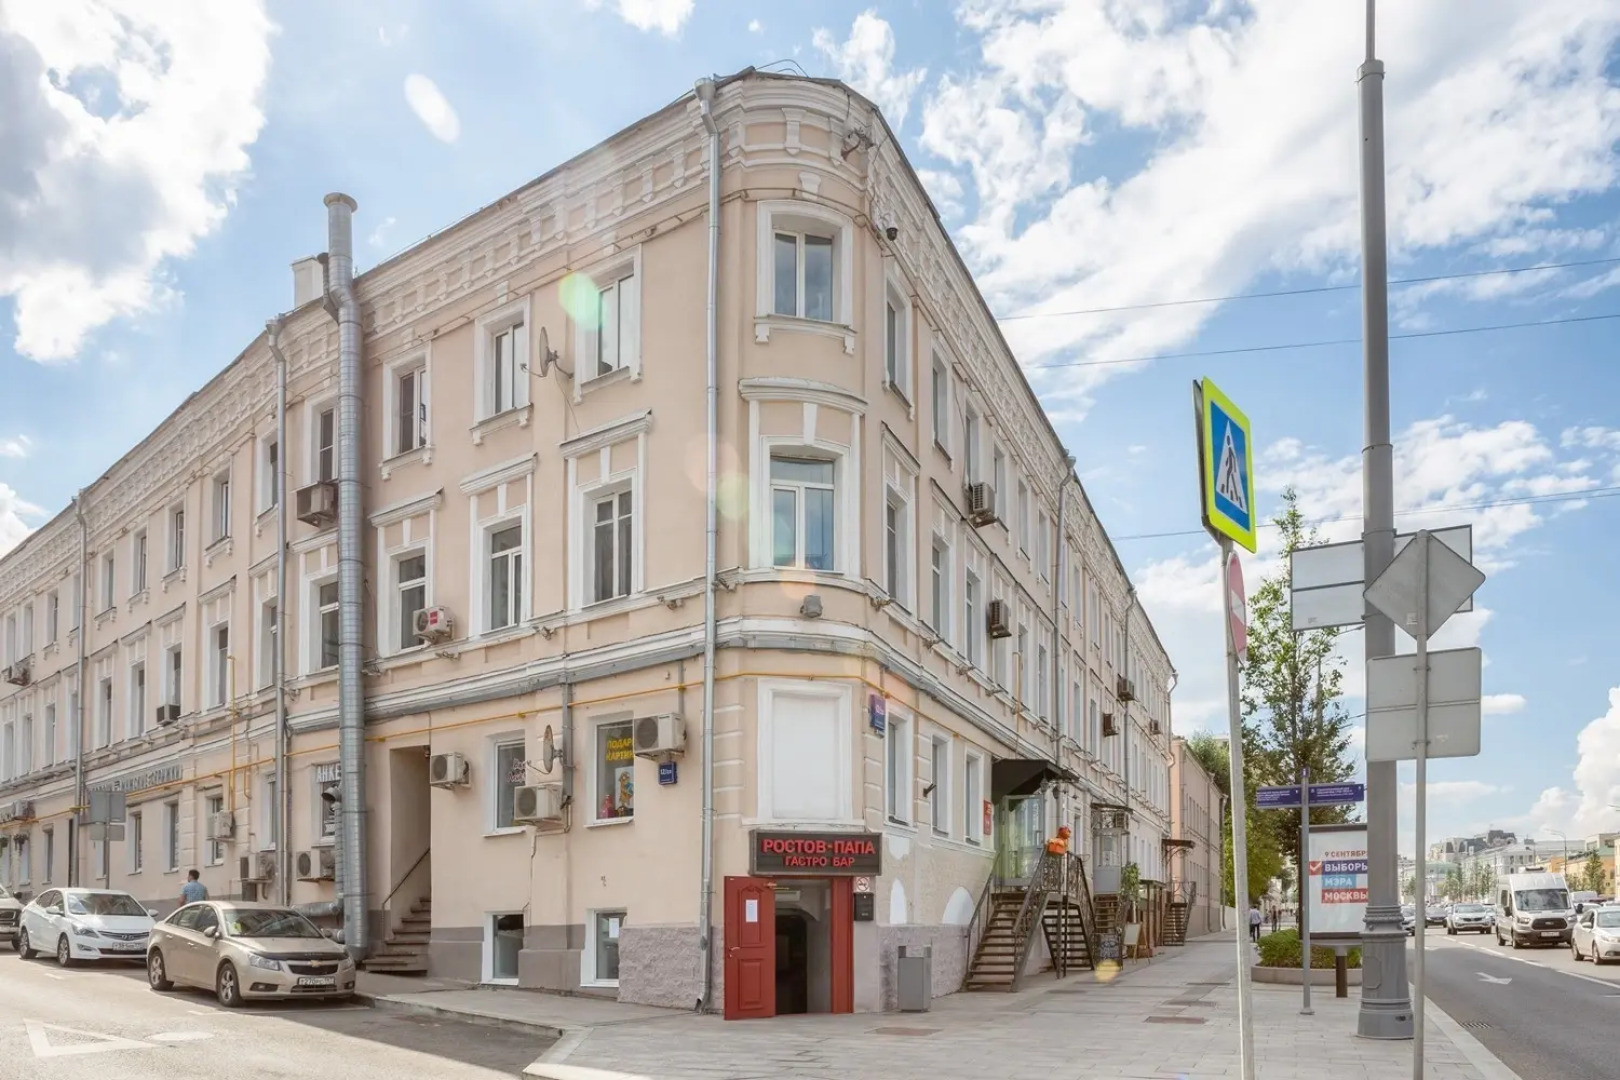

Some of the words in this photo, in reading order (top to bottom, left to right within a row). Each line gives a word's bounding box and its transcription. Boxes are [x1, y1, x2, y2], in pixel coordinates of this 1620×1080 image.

[607, 738, 633, 749] ПОДАР
[762, 838, 876, 854] РОСТОВ-ПАПА
[1331, 850, 1367, 858] СЕНТЯБР
[785, 856, 827, 866] ГАСТРО
[833, 856, 855, 867] БАР
[1324, 877, 1353, 887] МЭРА
[1324, 891, 1368, 901] МОСКВЫ
